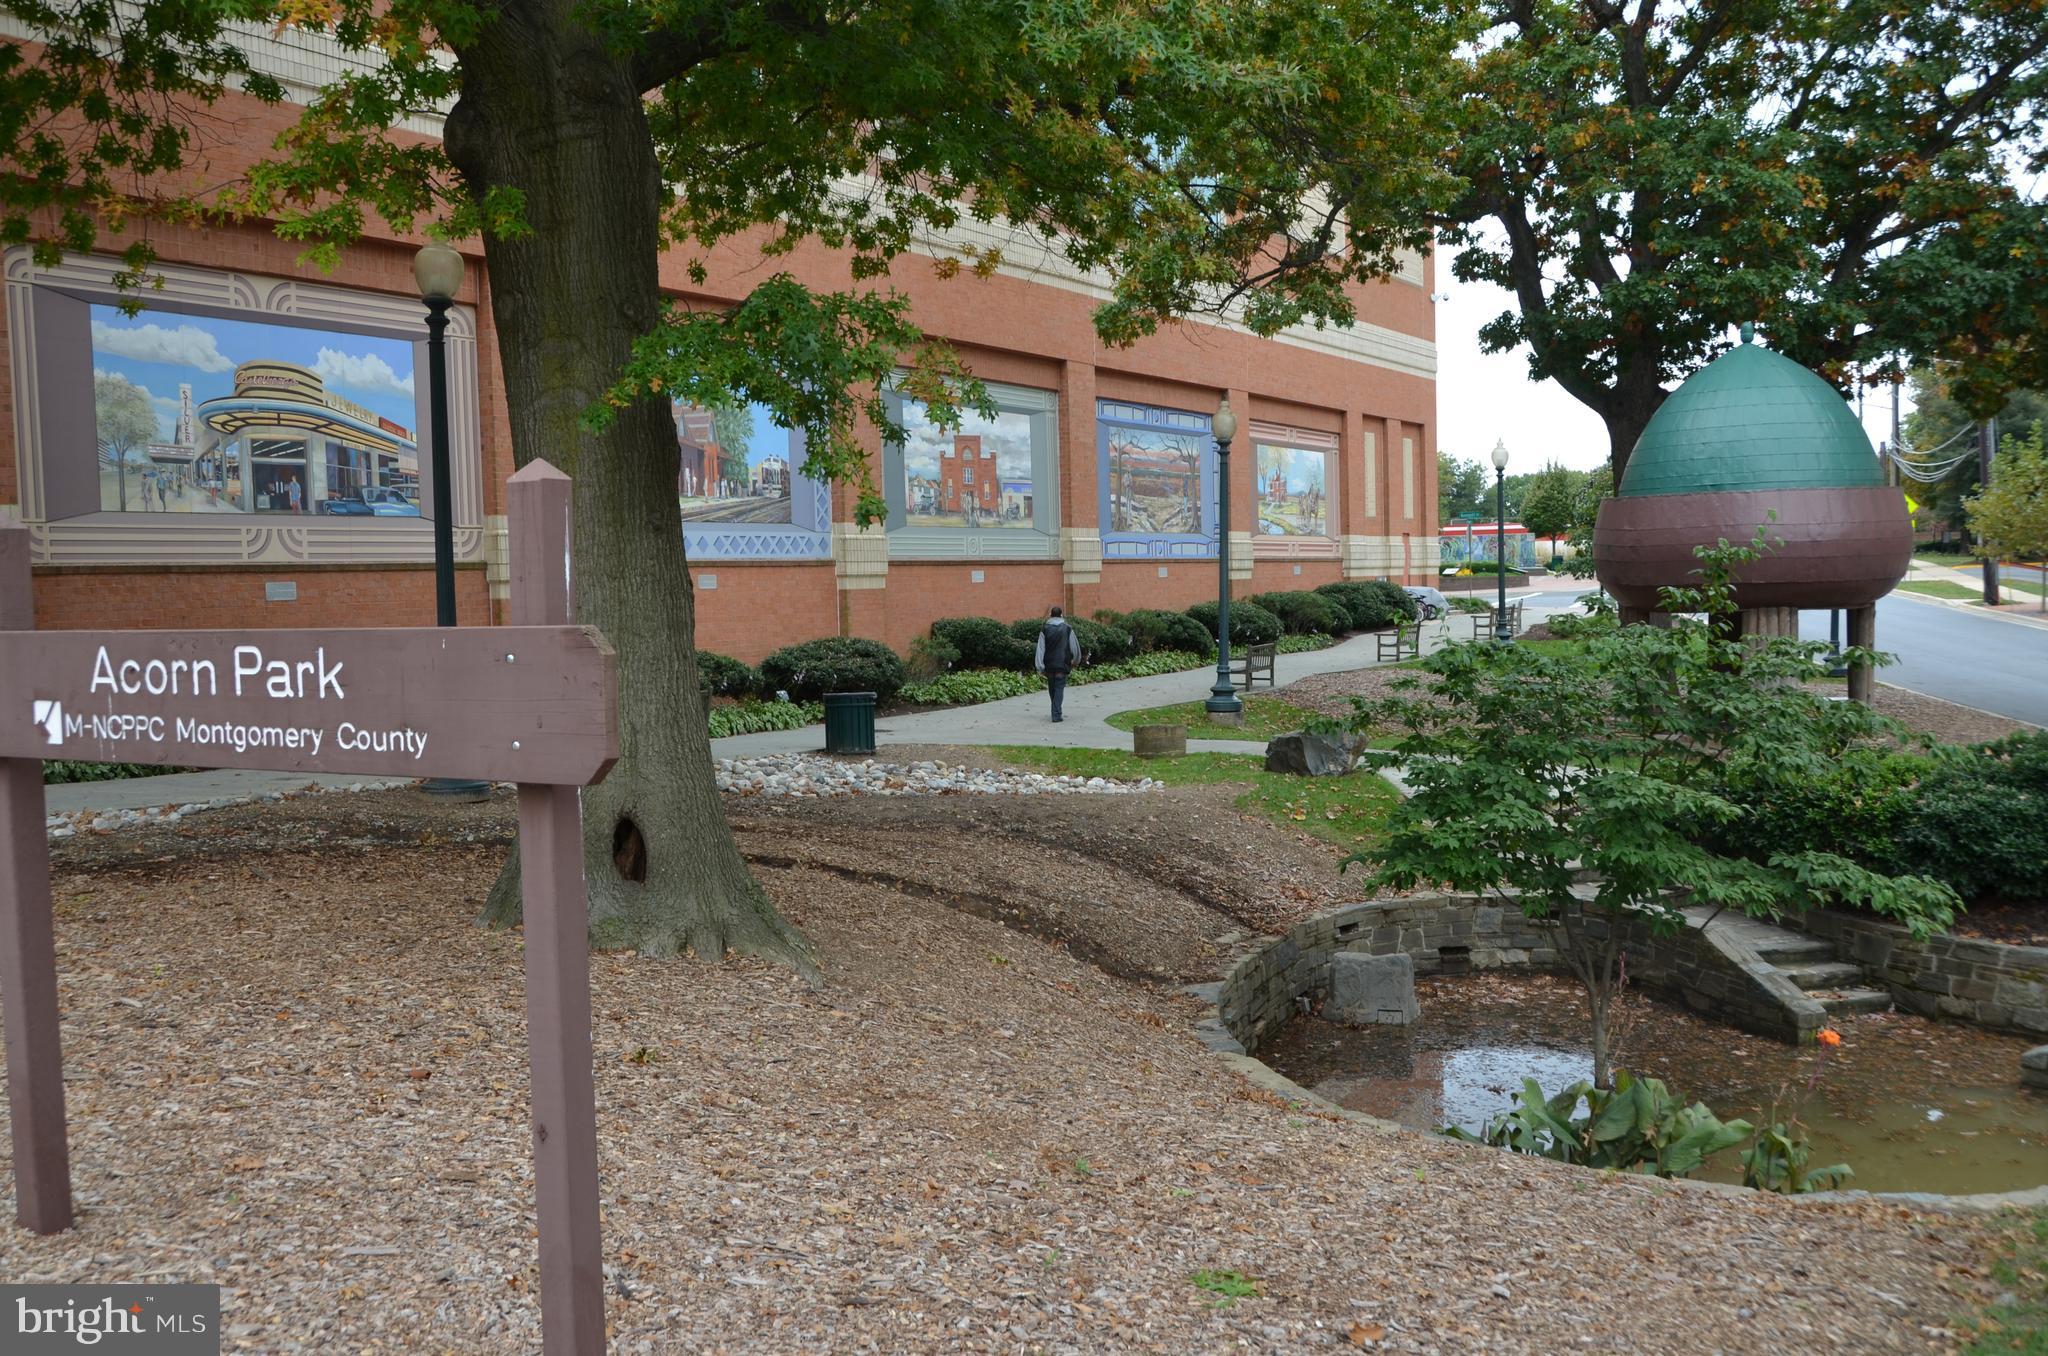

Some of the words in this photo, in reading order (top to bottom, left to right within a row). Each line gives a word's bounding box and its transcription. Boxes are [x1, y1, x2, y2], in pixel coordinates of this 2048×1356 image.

[182, 390, 191, 443] SILVER
[91, 646, 217, 695] Acorn
[235, 646, 345, 699] Park
[65, 713, 164, 742] M-NCPPC
[177, 718, 323, 755] Montgomery
[338, 722, 428, 760] County
